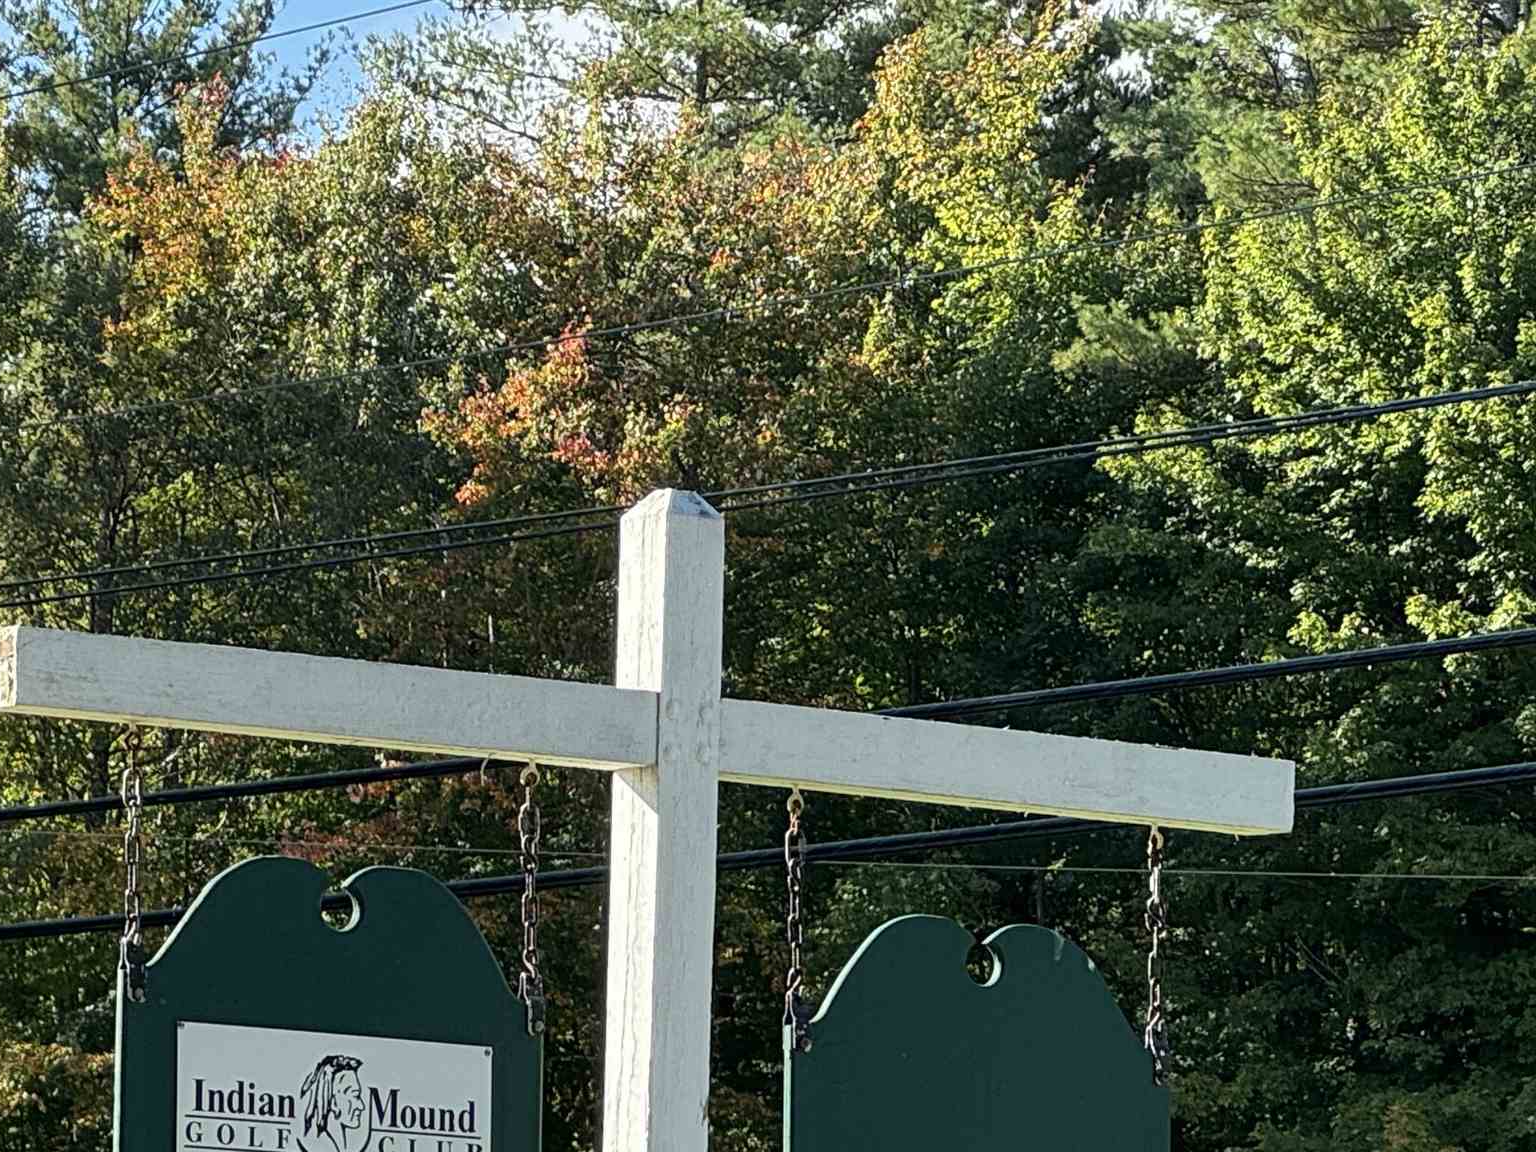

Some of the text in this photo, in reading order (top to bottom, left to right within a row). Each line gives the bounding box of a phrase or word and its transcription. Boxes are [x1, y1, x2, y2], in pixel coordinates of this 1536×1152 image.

[192, 1078, 476, 1133] Indian Mound
[185, 1121, 292, 1150] GOLF
